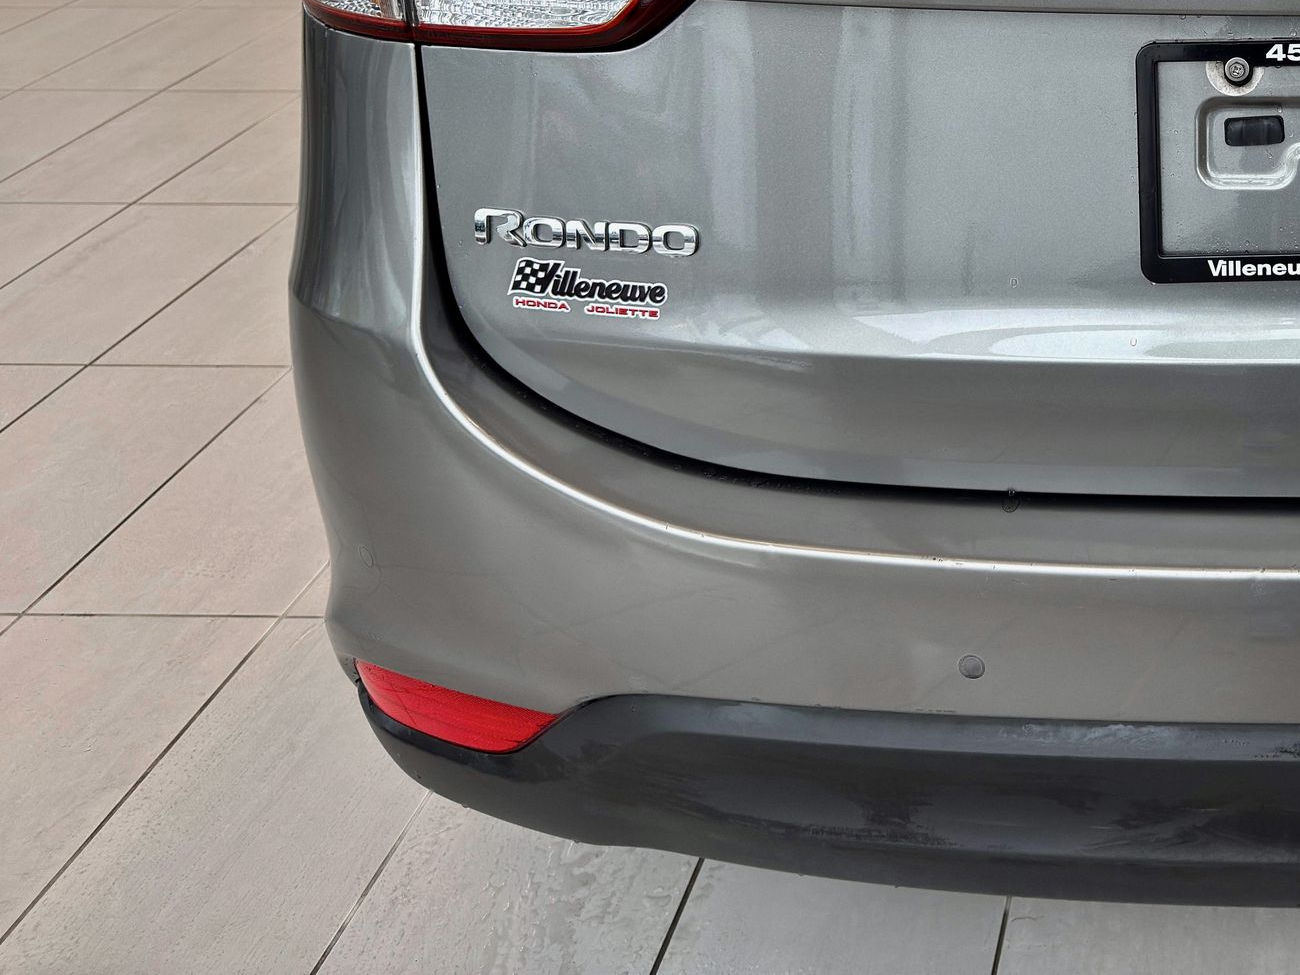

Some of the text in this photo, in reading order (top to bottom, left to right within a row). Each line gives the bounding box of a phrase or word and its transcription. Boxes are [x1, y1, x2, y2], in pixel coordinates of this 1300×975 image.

[537, 262, 666, 304] Villeneuve
[515, 298, 659, 318] HONDA JOLIETTE
